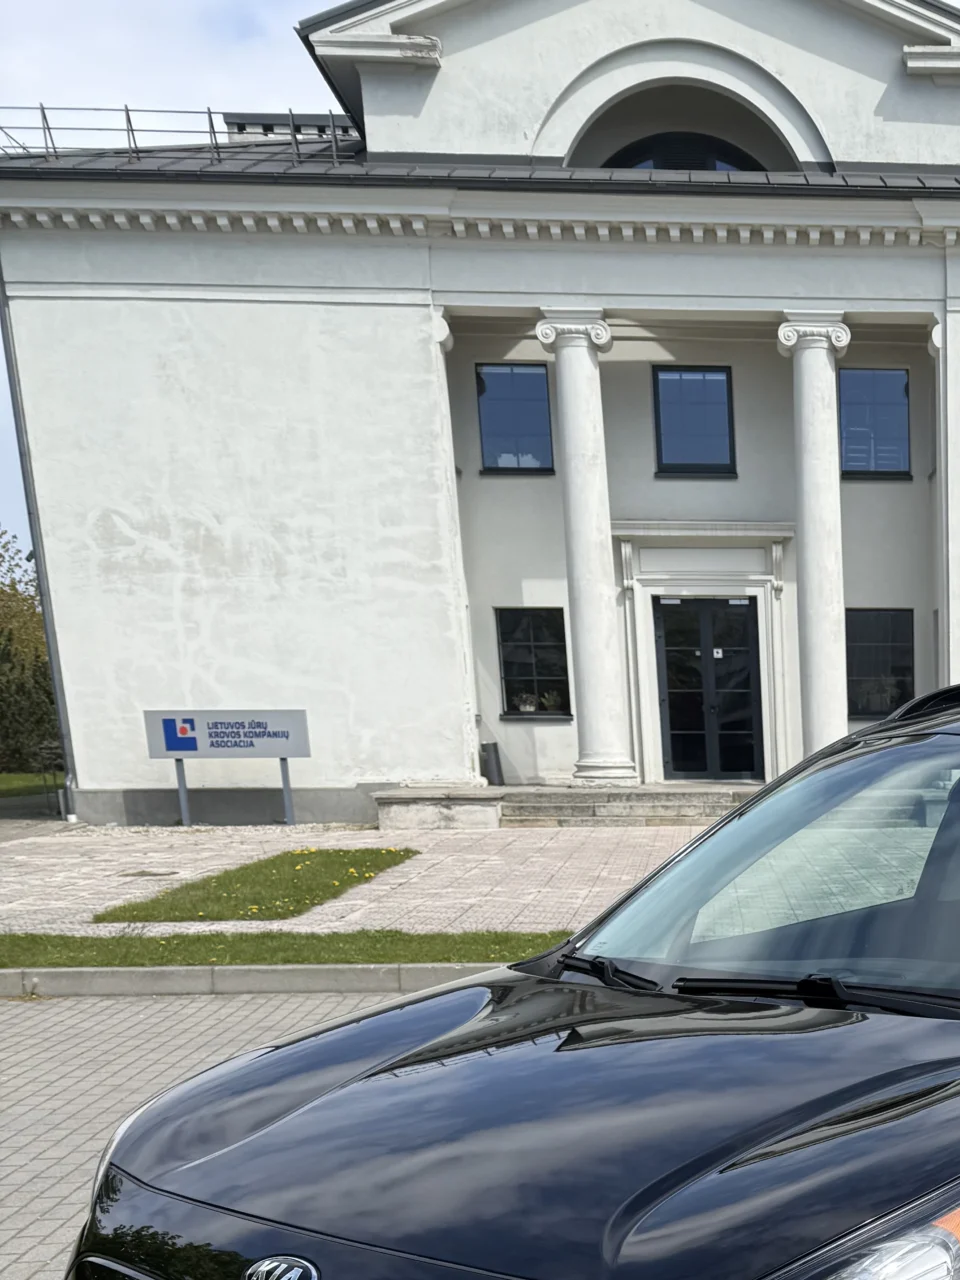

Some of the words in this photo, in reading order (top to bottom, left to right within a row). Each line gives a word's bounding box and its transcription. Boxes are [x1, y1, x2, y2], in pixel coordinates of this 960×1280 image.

[207, 721, 246, 730] LIETUVOS
[248, 719, 268, 731] JŪRŲ
[208, 730, 242, 739] KROVOS
[243, 730, 289, 741] KOMPANIJŲ
[209, 739, 255, 748] ASOCIACIJA
